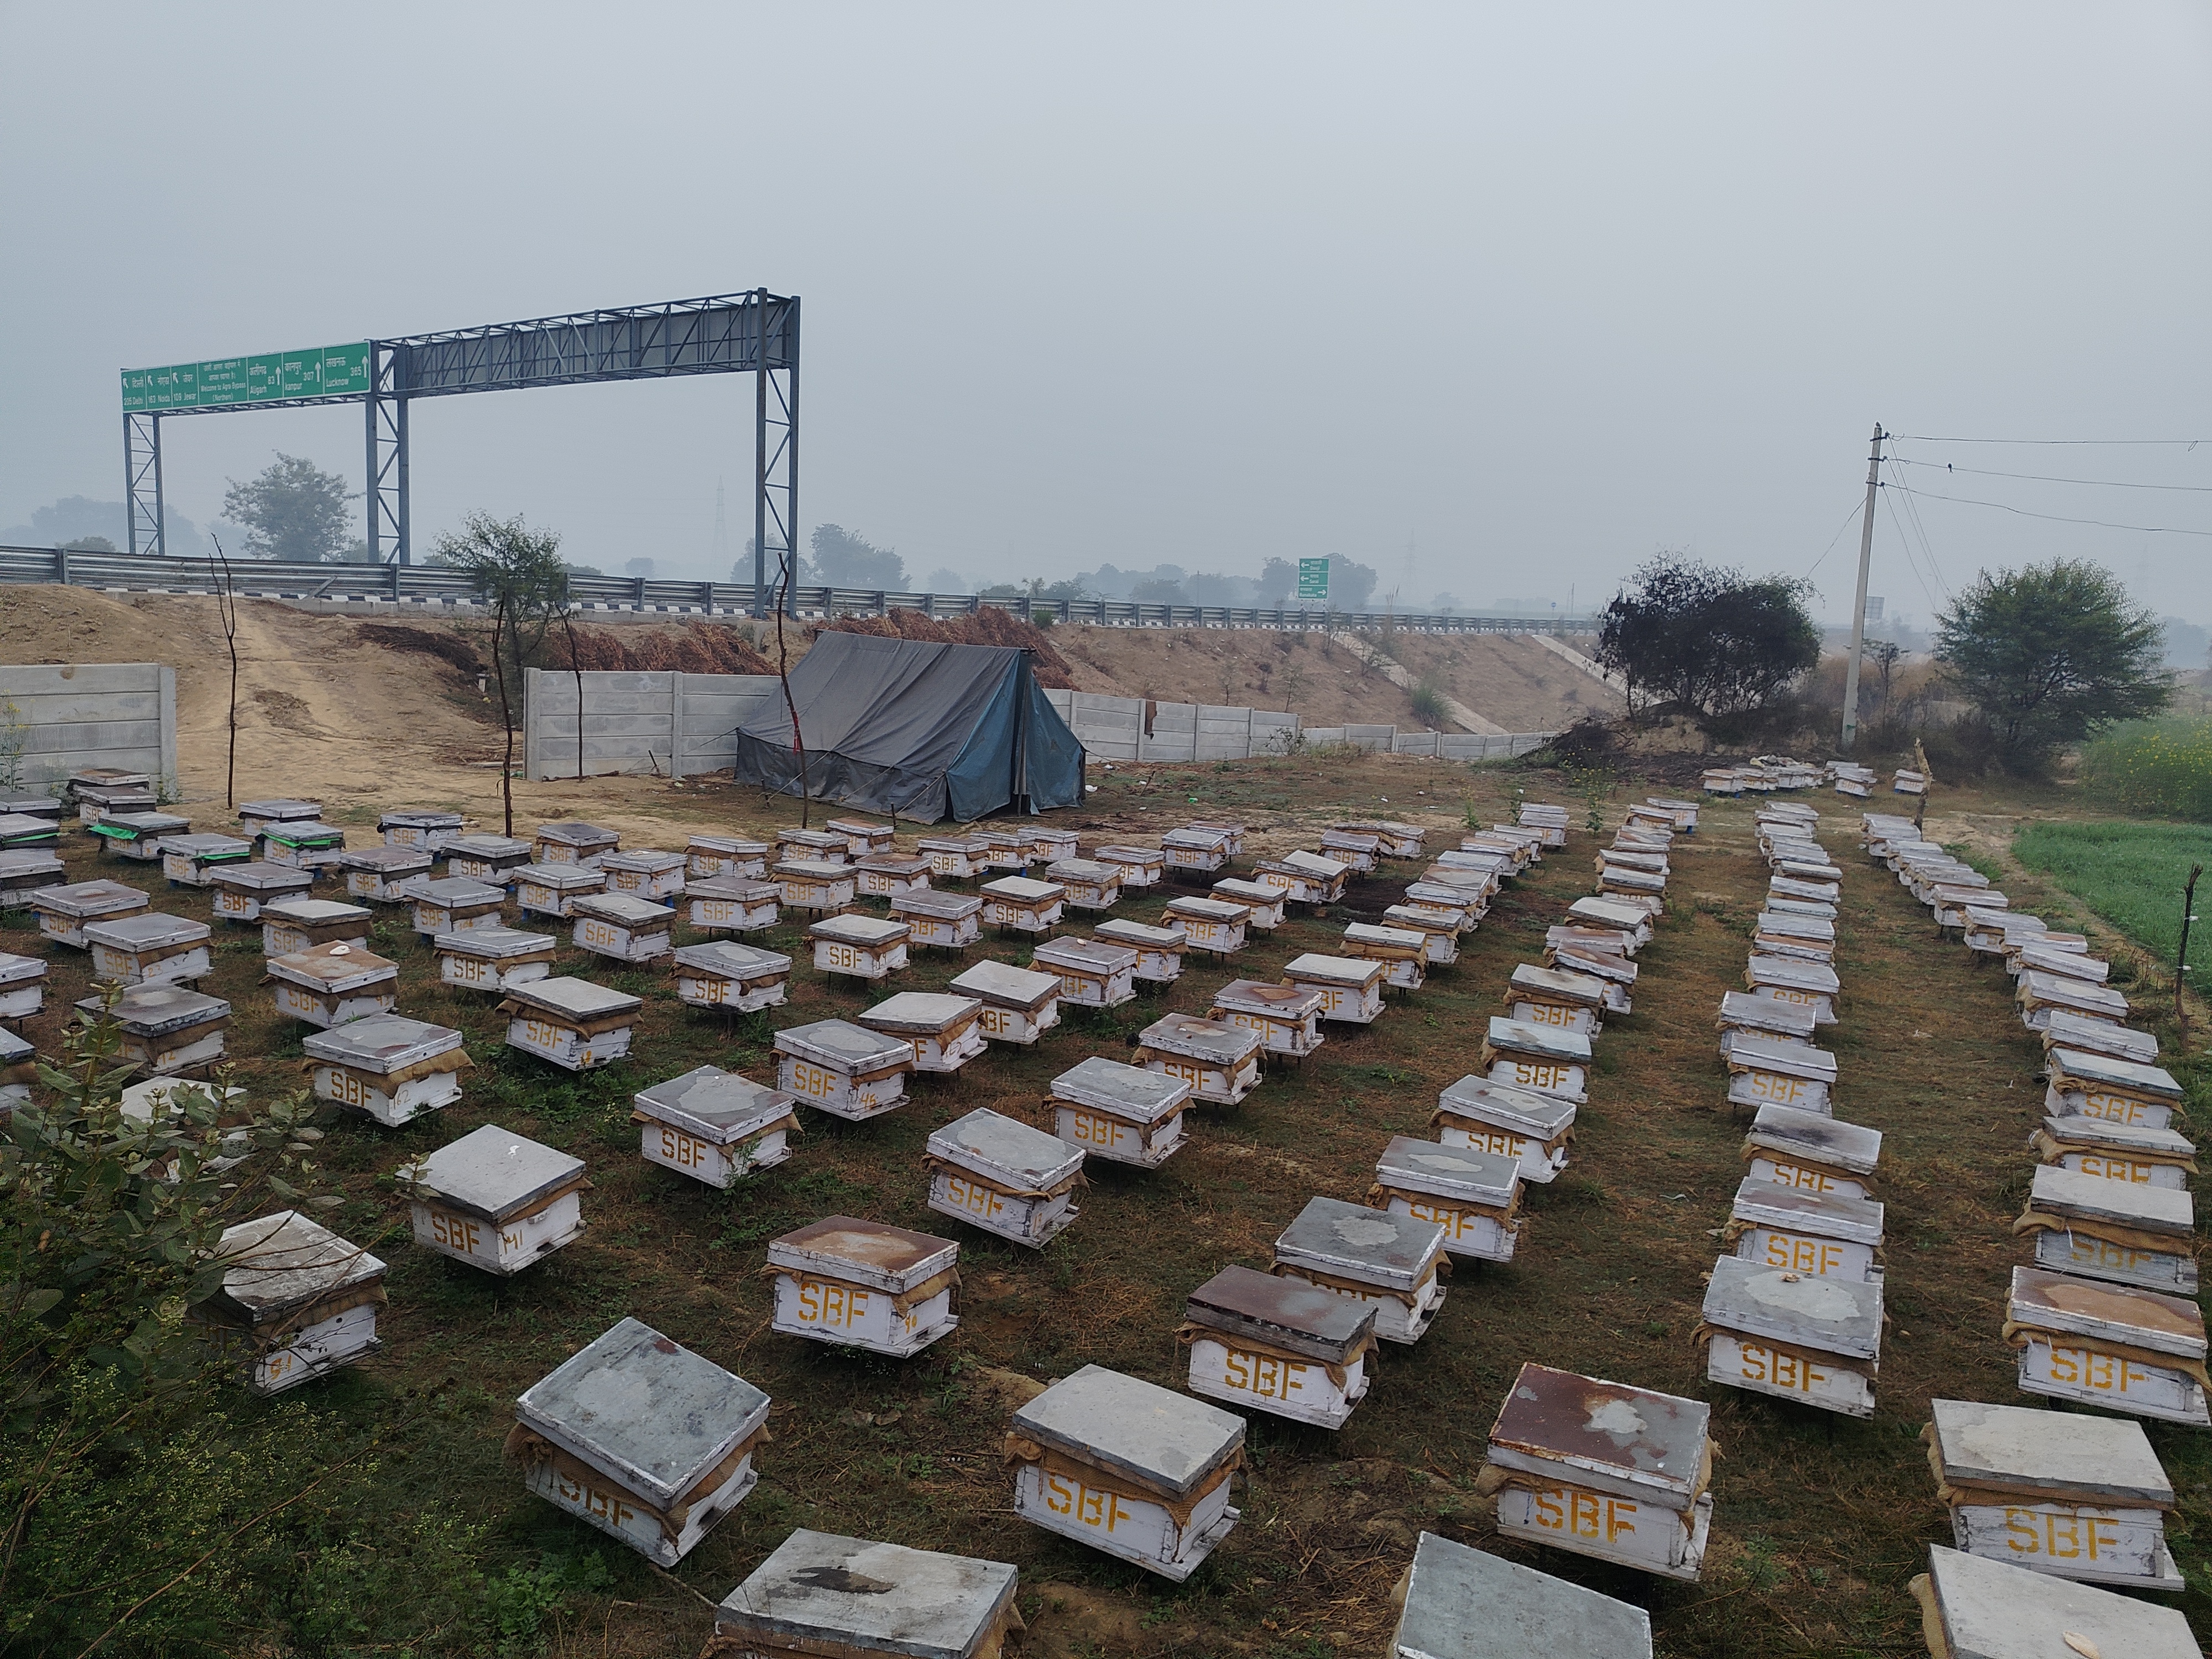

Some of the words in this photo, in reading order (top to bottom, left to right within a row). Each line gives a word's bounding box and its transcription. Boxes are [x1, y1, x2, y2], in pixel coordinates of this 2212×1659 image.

[284, 362, 302, 375] कानपुर
[303, 371, 314, 381] 307
[394, 829, 417, 844] SBF
[550, 846, 571, 862] SBF
[789, 845, 814, 860] SBF
[933, 856, 958, 871] SBF
[1175, 850, 1201, 864] SBF
[1333, 851, 1360, 864] SBF
[170, 857, 190, 877] SBF
[461, 860, 488, 877] SBF
[699, 856, 723, 872] SBF
[356, 873, 377, 893] SBF
[617, 872, 642, 889] SBF
[868, 876, 895, 891] SBF
[526, 886, 551, 905] SBF
[787, 884, 817, 901] SBF
[222, 893, 251, 915] SBF
[703, 902, 734, 921] SBF
[996, 905, 1026, 924] SBF
[49, 916, 72, 934] SBF
[421, 910, 444, 926] SBF
[273, 930, 301, 952] SBF
[586, 922, 618, 946] SBF
[1184, 921, 1219, 940] SBF
[103, 952, 133, 976] SBF
[830, 946, 863, 968] SBF
[453, 958, 486, 982] SBF
[288, 990, 320, 1013] SBF
[695, 979, 731, 1003] SBF
[1532, 1005, 1579, 1027] SBF
[526, 1021, 566, 1049] SBF
[795, 1064, 837, 1098] SBF
[1515, 1063, 1570, 1089] SBF
[331, 1071, 374, 1107] SBF
[1751, 1073, 1808, 1103] SBF
[2084, 1094, 2148, 1123] SBF
[1074, 1112, 1125, 1146] SBF
[661, 1129, 707, 1168] SBF
[1467, 1131, 1526, 1157] SBF
[948, 1175, 1003, 1218] SBF
[431, 1211, 481, 1254] SBF
[1767, 1235, 1843, 1275] SBF
[798, 1281, 868, 1328] SBF
[1224, 1348, 1307, 1400] SBF
[1742, 1344, 1825, 1392] SBF
[2051, 1347, 2146, 1392] SBF
[1047, 1472, 1137, 1533] SBF
[1536, 1489, 1637, 1543] SBF
[2006, 1508, 2120, 1561] SBF
